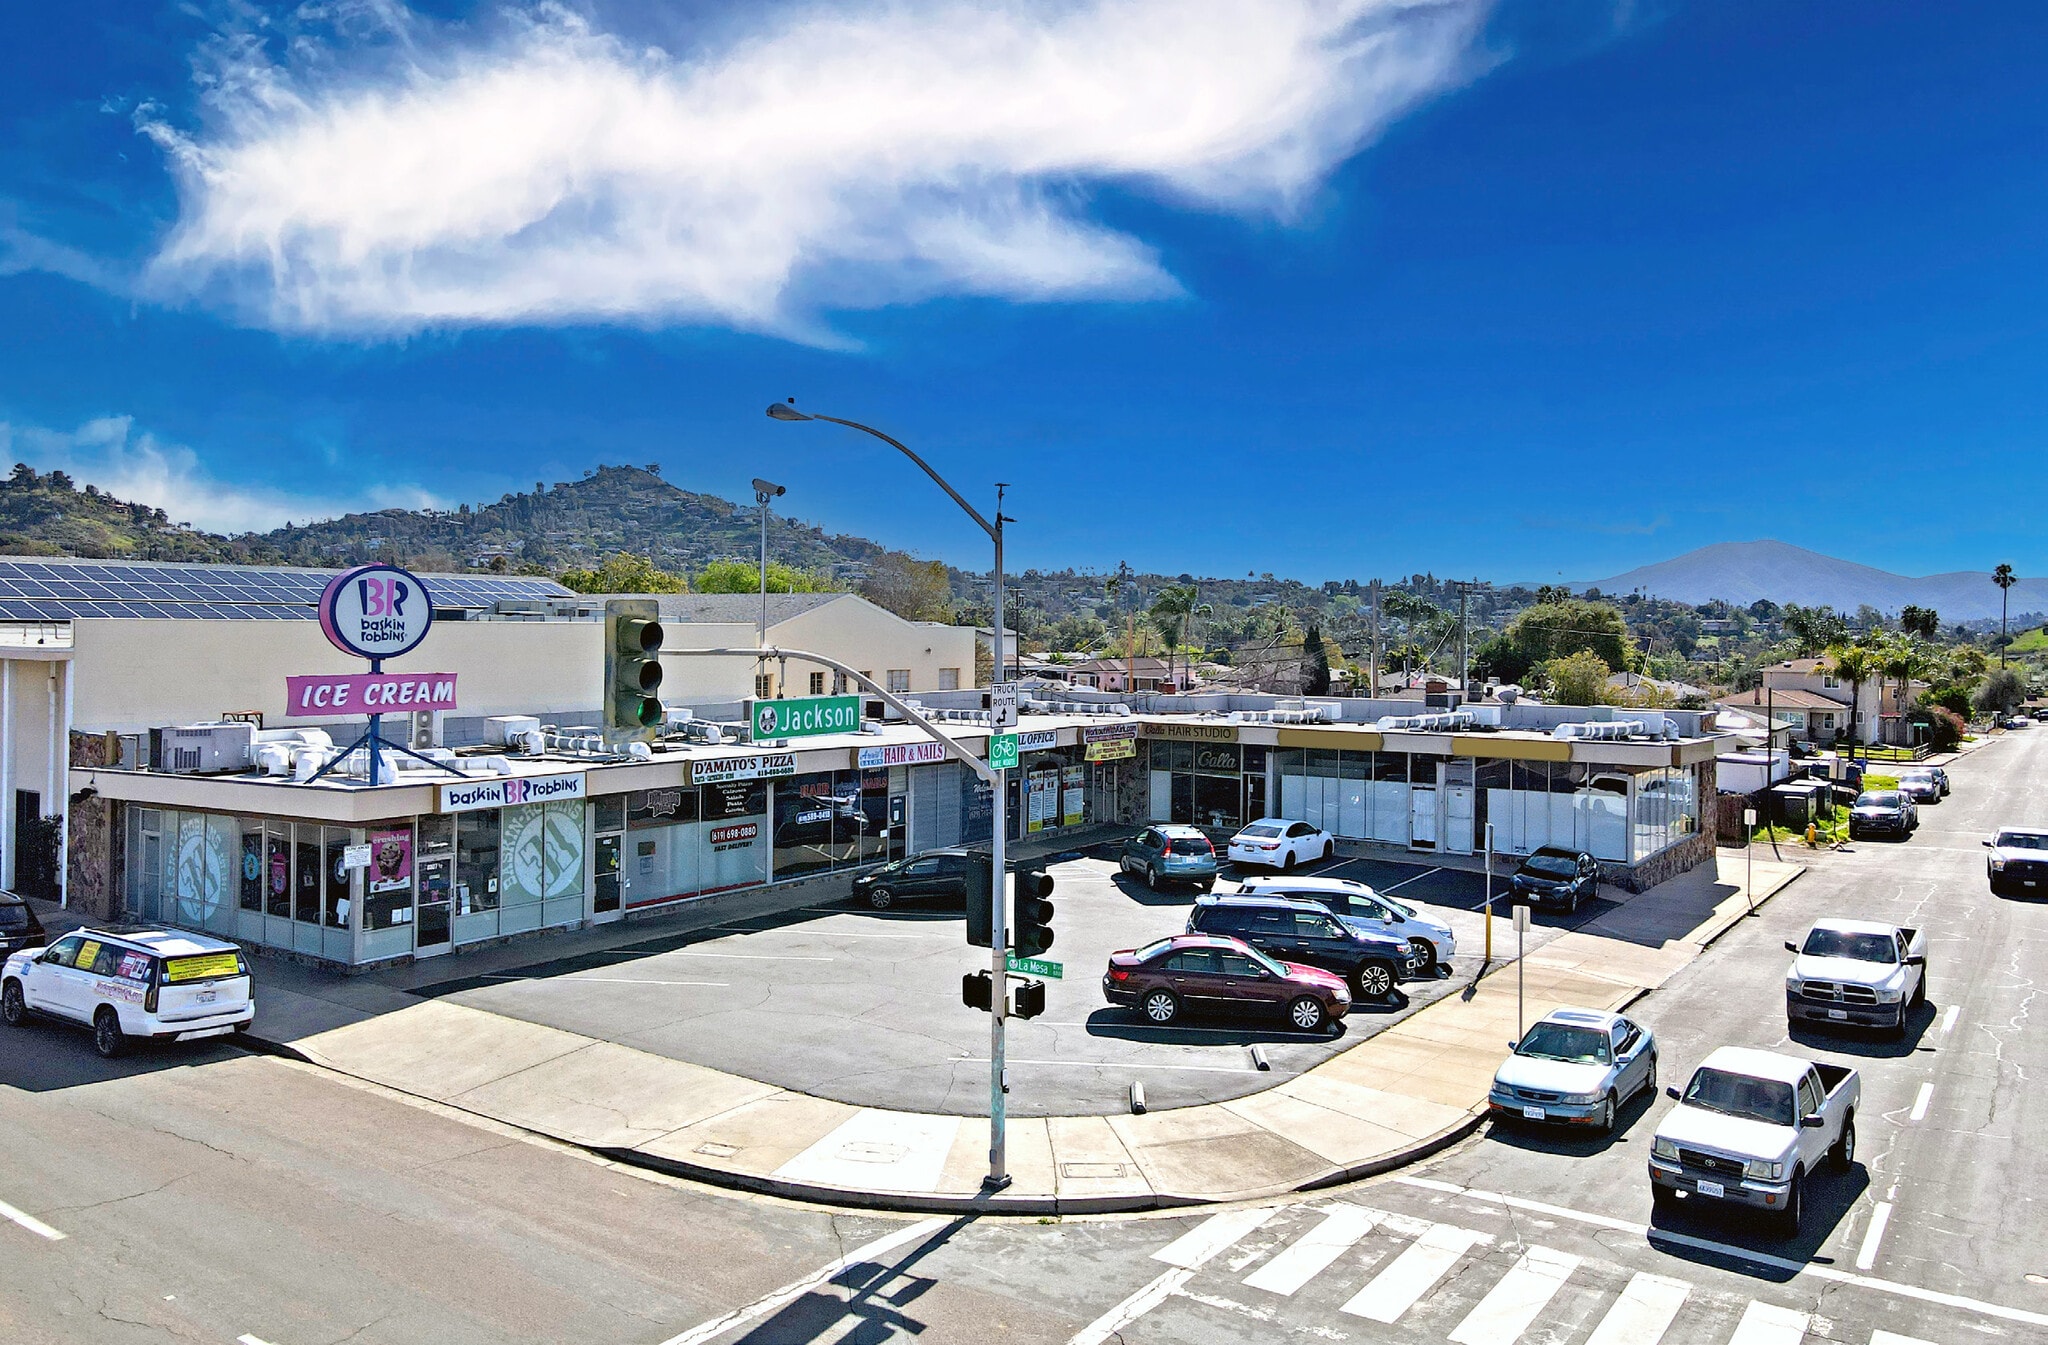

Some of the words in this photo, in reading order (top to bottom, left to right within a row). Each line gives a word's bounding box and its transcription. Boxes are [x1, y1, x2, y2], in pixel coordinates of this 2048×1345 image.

[358, 578, 409, 617] BR
[361, 618, 405, 631] baskin
[361, 629, 405, 642] robbins
[301, 684, 350, 708] ICE
[363, 681, 454, 706] CREAM
[993, 685, 1016, 695] TRUCK
[993, 697, 1016, 707] ROUTE
[781, 704, 854, 732] Jackson
[1027, 732, 1055, 745] OFFICE
[1168, 726, 1191, 736] HAIR
[1193, 727, 1232, 738] STUDIO
[884, 746, 906, 765] HAIR
[908, 748, 915, 761] &
[917, 743, 943, 761] NAILS
[694, 758, 757, 775] D'AMATO'S
[762, 754, 794, 768] PIZZA
[449, 787, 500, 806] baskin
[533, 778, 578, 796] robbins
[726, 826, 756, 839] 698-0880
[1018, 960, 1028, 971] La
[1030, 961, 1048, 974] Mesa
